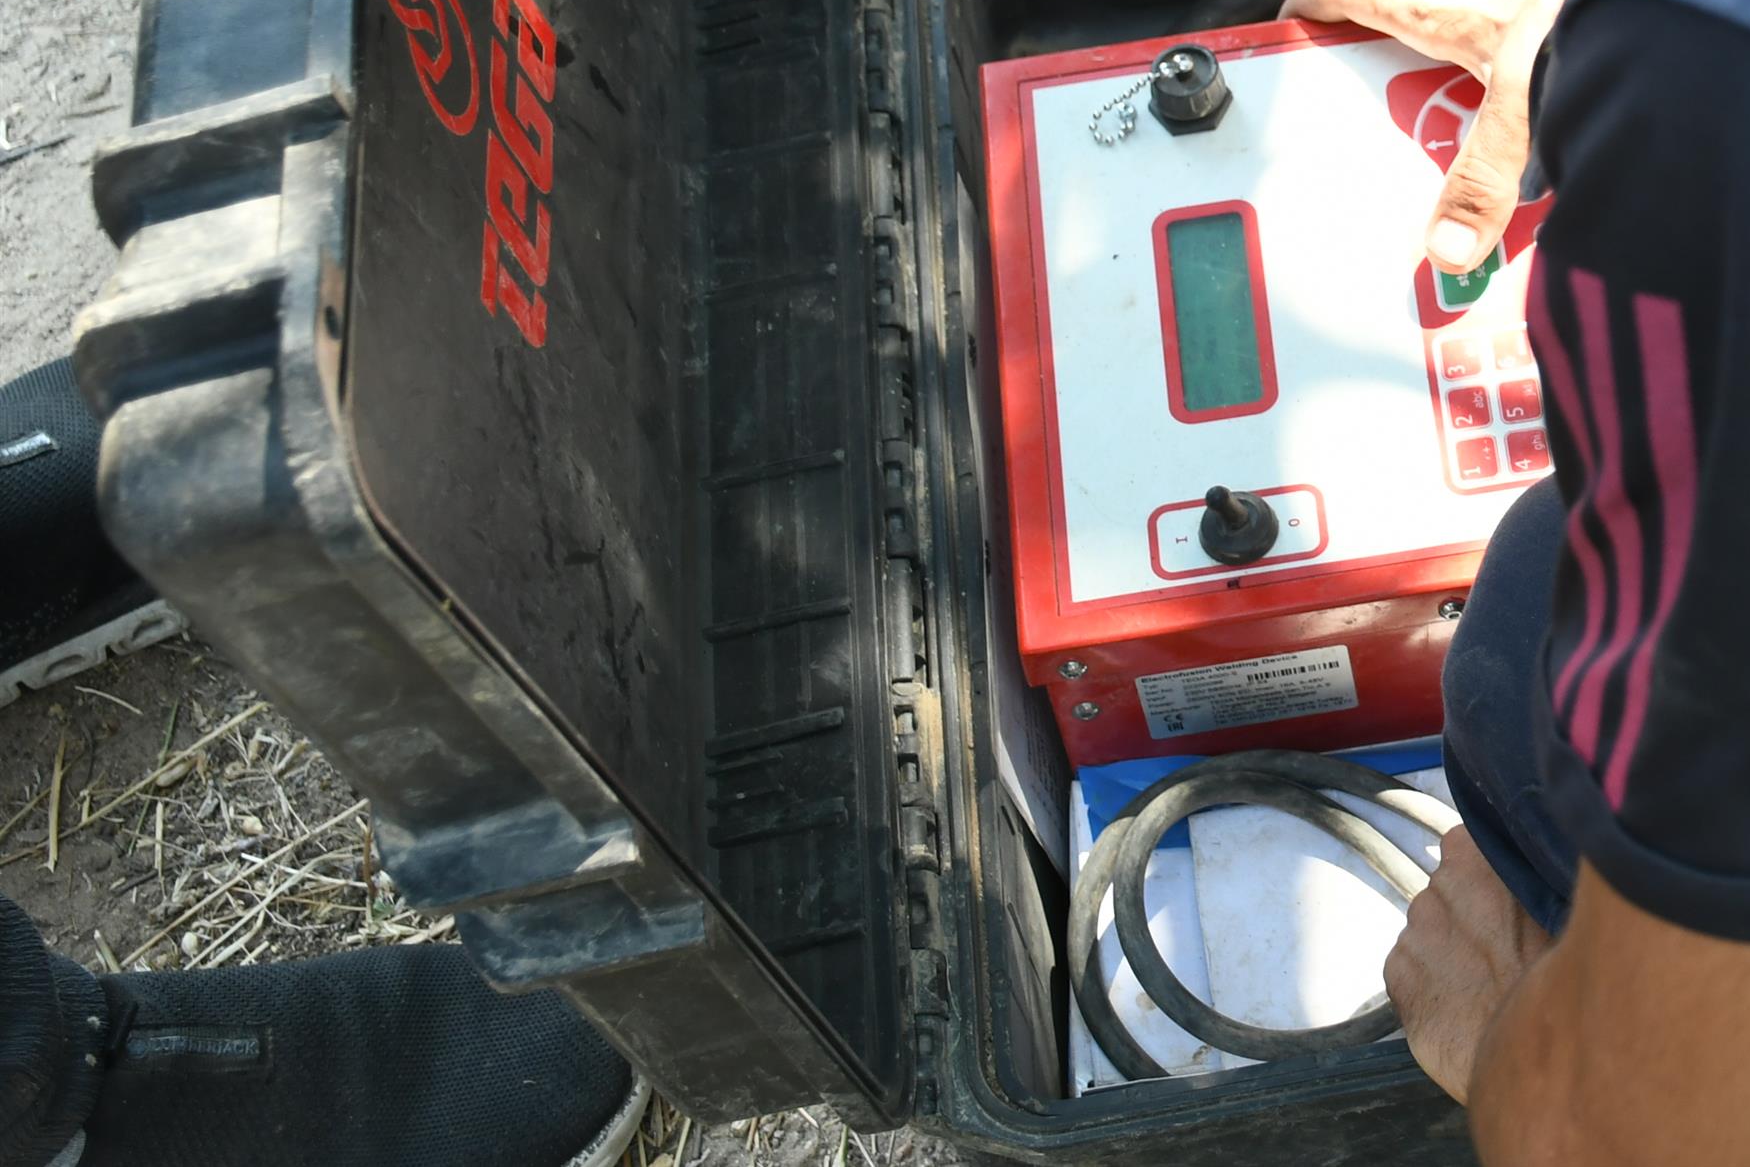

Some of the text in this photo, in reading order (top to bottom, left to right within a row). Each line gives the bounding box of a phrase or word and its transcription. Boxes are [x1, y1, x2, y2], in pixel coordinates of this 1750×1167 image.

[1449, 364, 1465, 375] 3
[1473, 391, 1484, 408] abc
[1507, 407, 1523, 417] 5
[1456, 414, 1473, 426] 2
[1532, 434, 1545, 450] ghi
[1515, 458, 1531, 469] 4
[1464, 466, 1480, 476] 1
